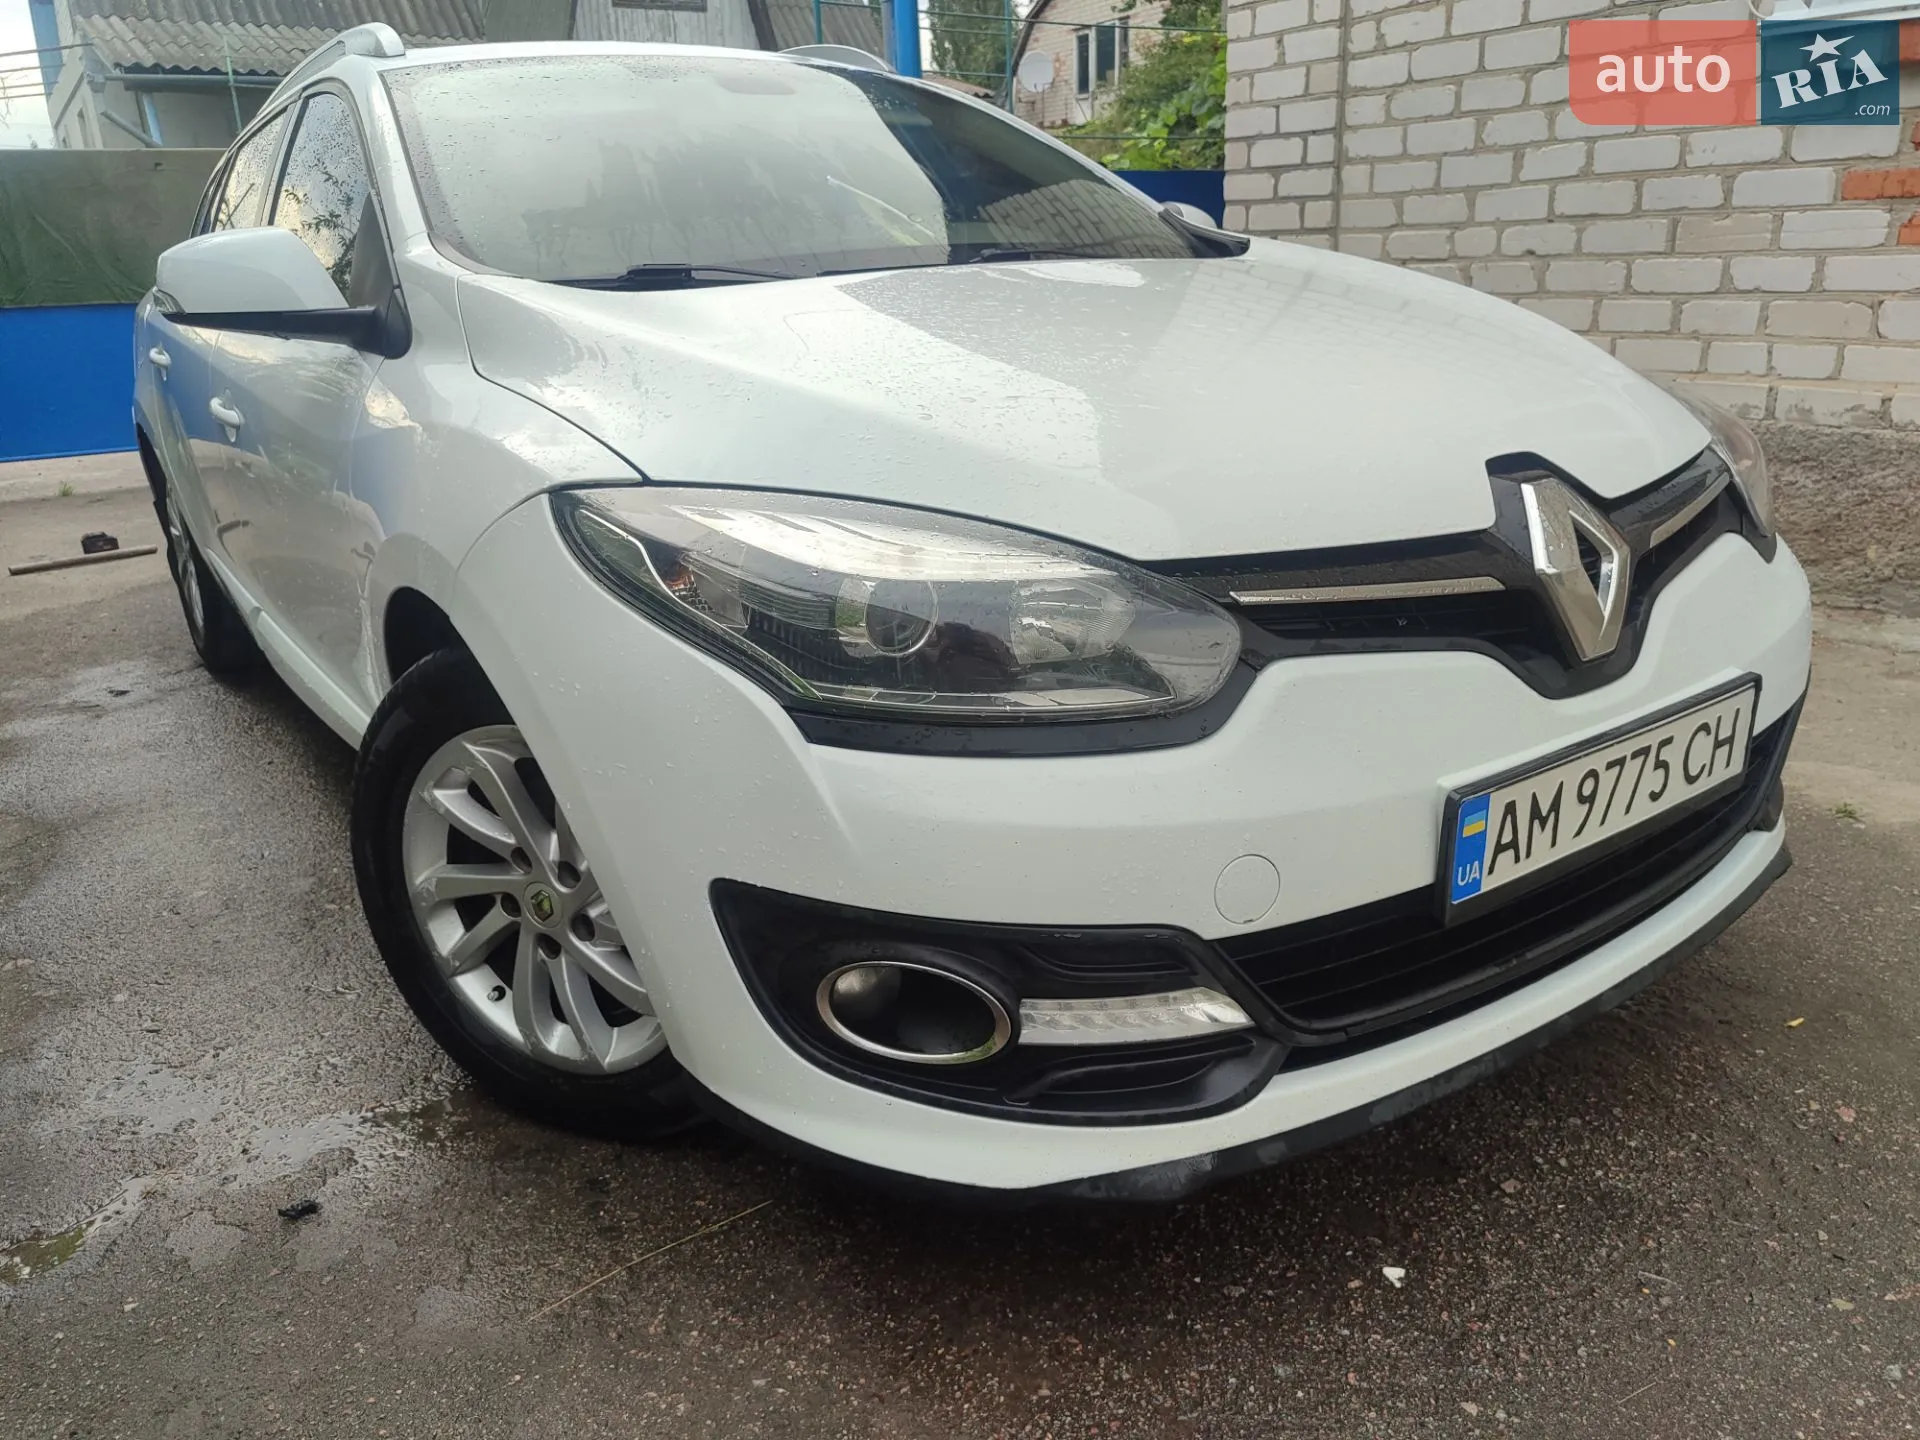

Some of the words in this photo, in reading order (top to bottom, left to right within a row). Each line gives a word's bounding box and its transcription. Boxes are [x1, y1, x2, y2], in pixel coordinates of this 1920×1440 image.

[1487, 780, 1564, 876] AM
[1572, 735, 1675, 839] 9775
[1682, 707, 1741, 785] CH
[1457, 860, 1480, 886] UA
